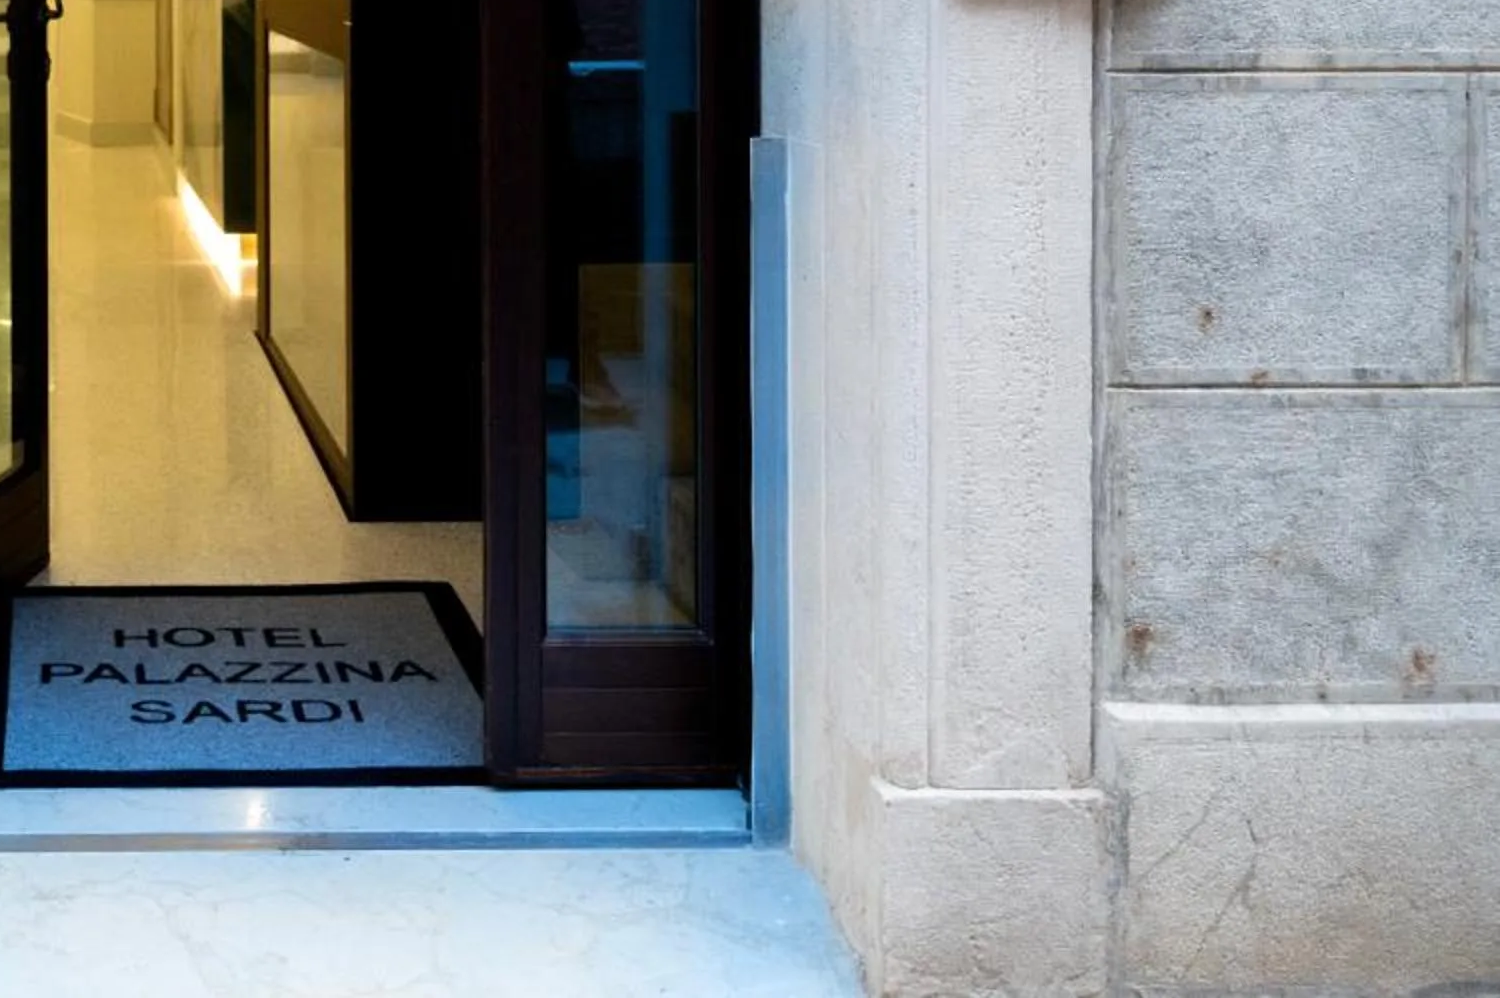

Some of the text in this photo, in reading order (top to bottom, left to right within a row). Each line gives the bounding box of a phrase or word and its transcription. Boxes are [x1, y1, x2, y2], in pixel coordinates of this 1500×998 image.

[114, 627, 348, 649] HOTEL
[40, 660, 438, 685] PALAZZINA
[130, 699, 365, 725] SARDI
